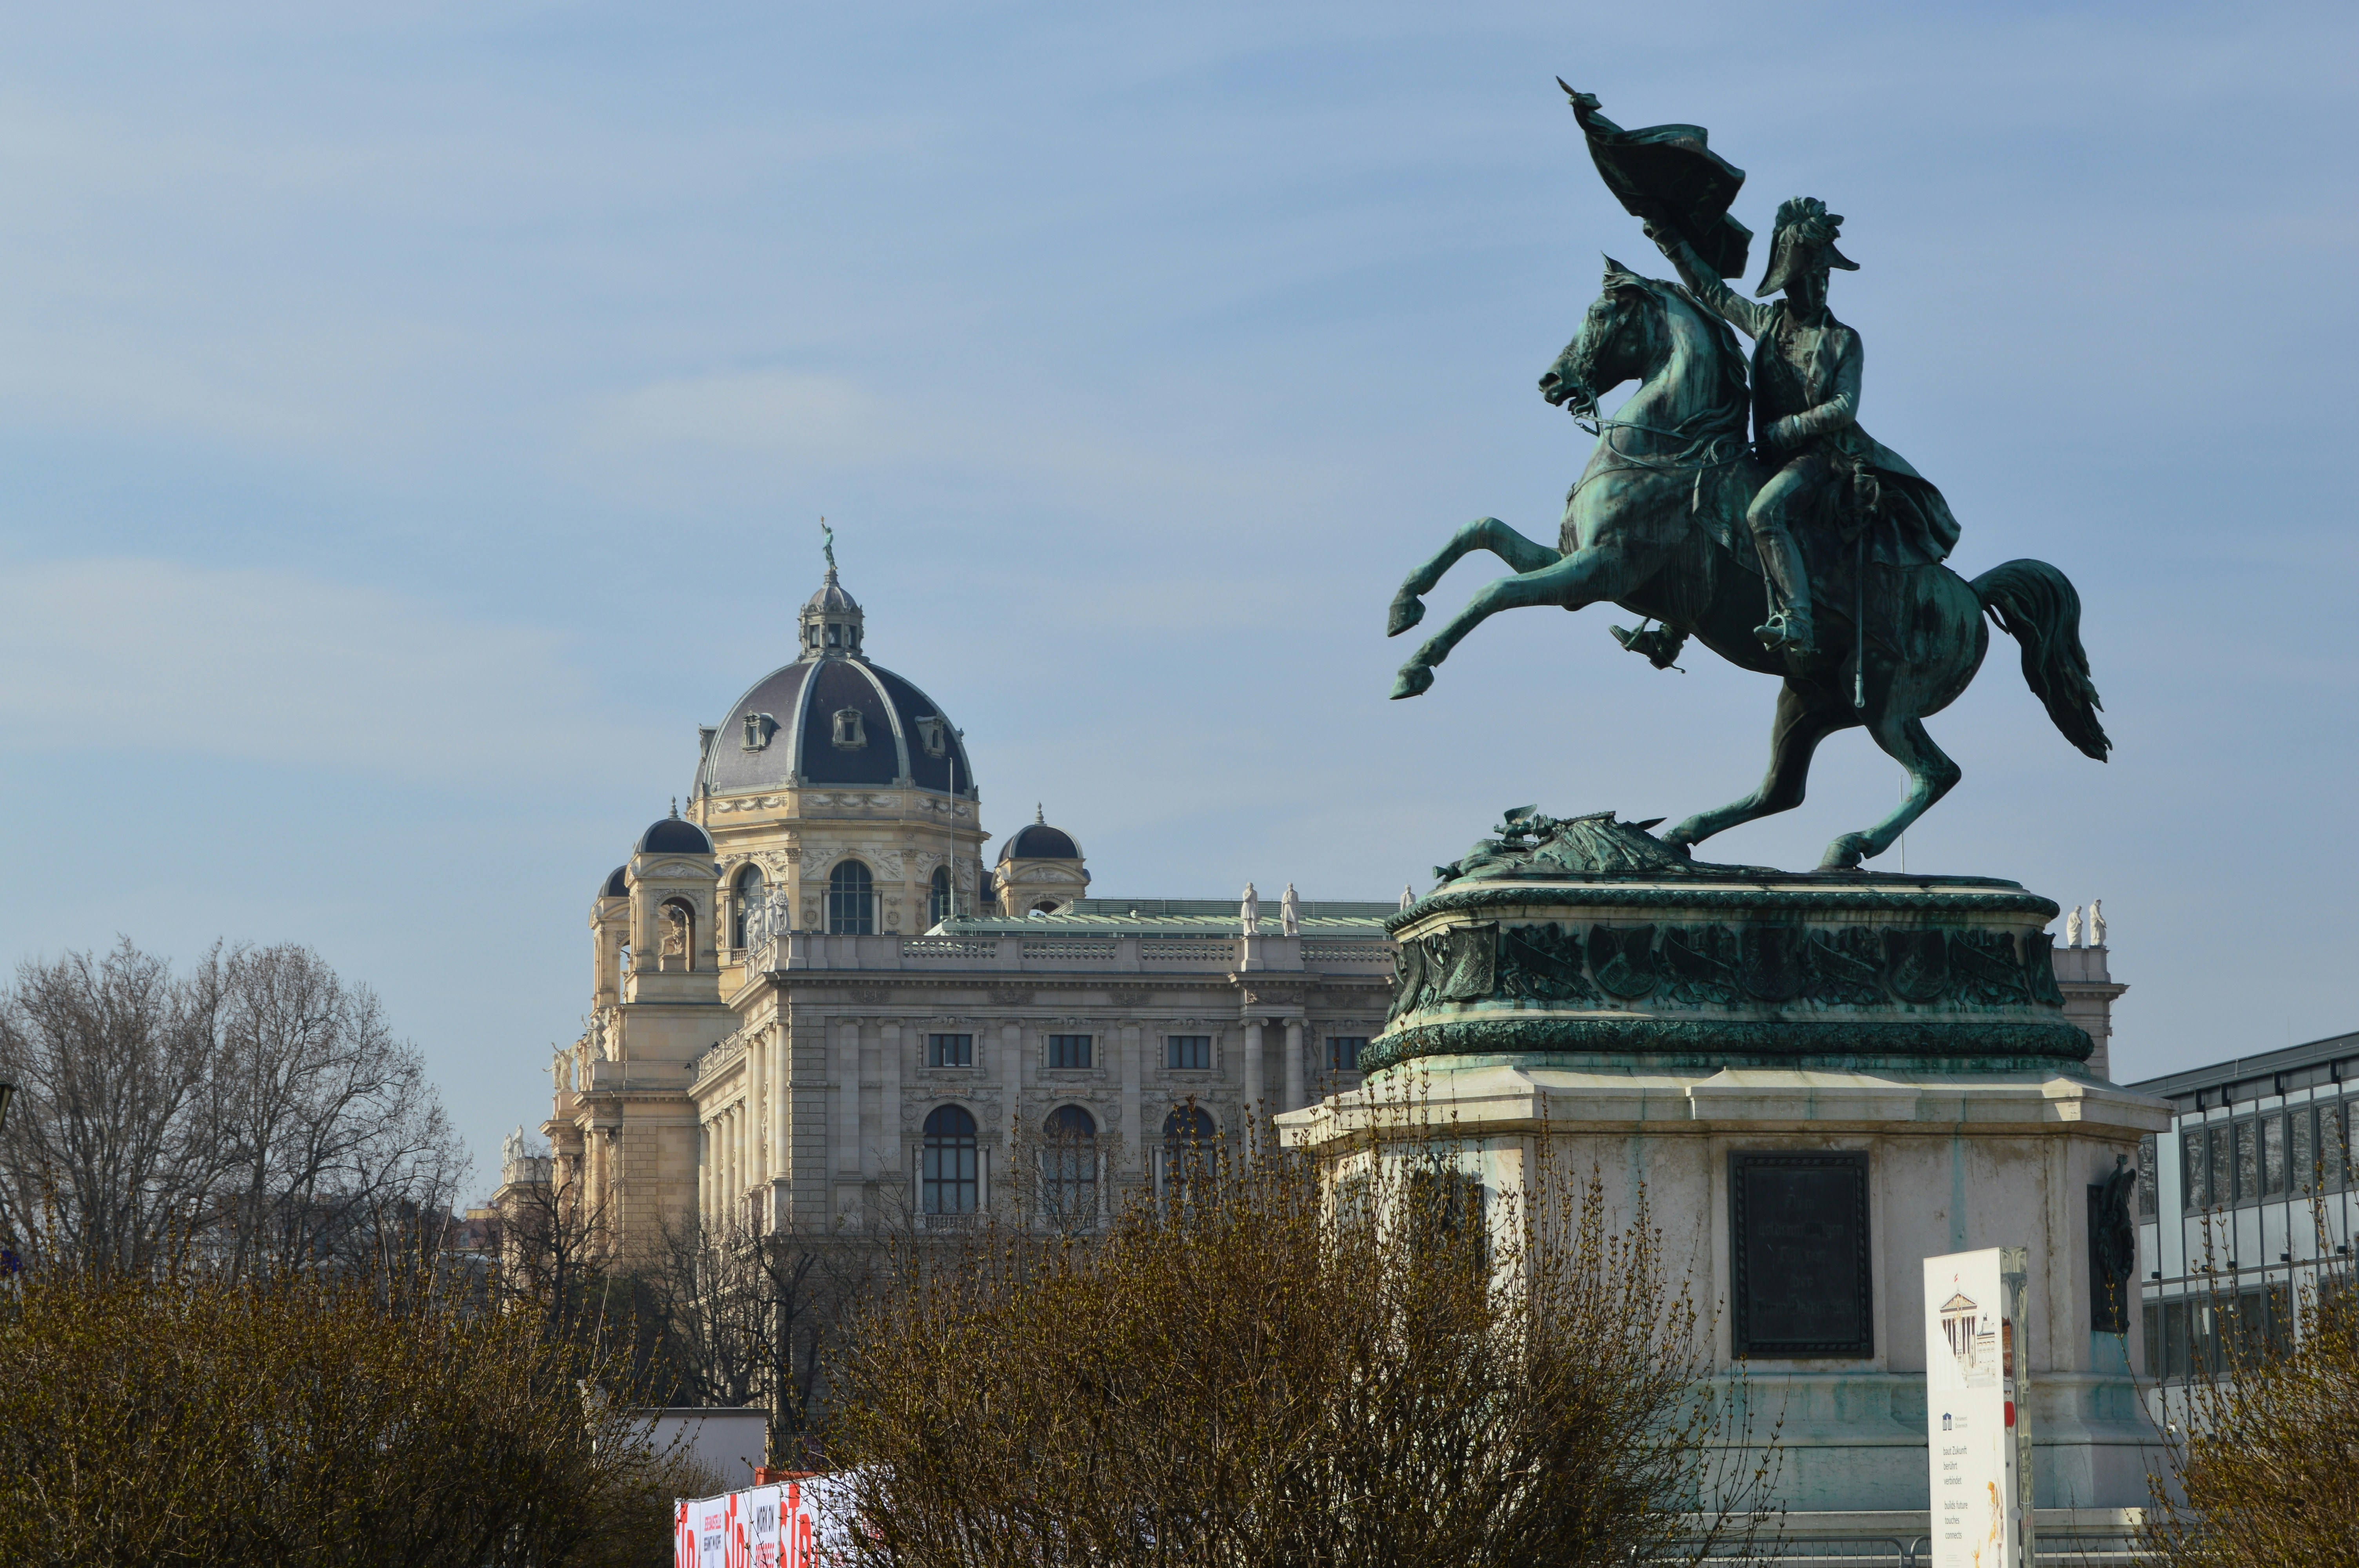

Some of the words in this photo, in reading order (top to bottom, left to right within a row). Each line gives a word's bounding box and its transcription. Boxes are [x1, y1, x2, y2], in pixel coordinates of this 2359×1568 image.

[1943, 1447, 1952, 1455] baut
[1952, 1446, 1967, 1455] Zukunft
[1943, 1461, 1957, 1470] berührt
[1944, 1475, 1962, 1485] verbindet
[1945, 1500, 1956, 1509] builds
[1956, 1500, 1968, 1509] future
[756, 1505, 768, 1533] WORK
[768, 1504, 774, 1532] ON
[1945, 1515, 1959, 1524] touches
